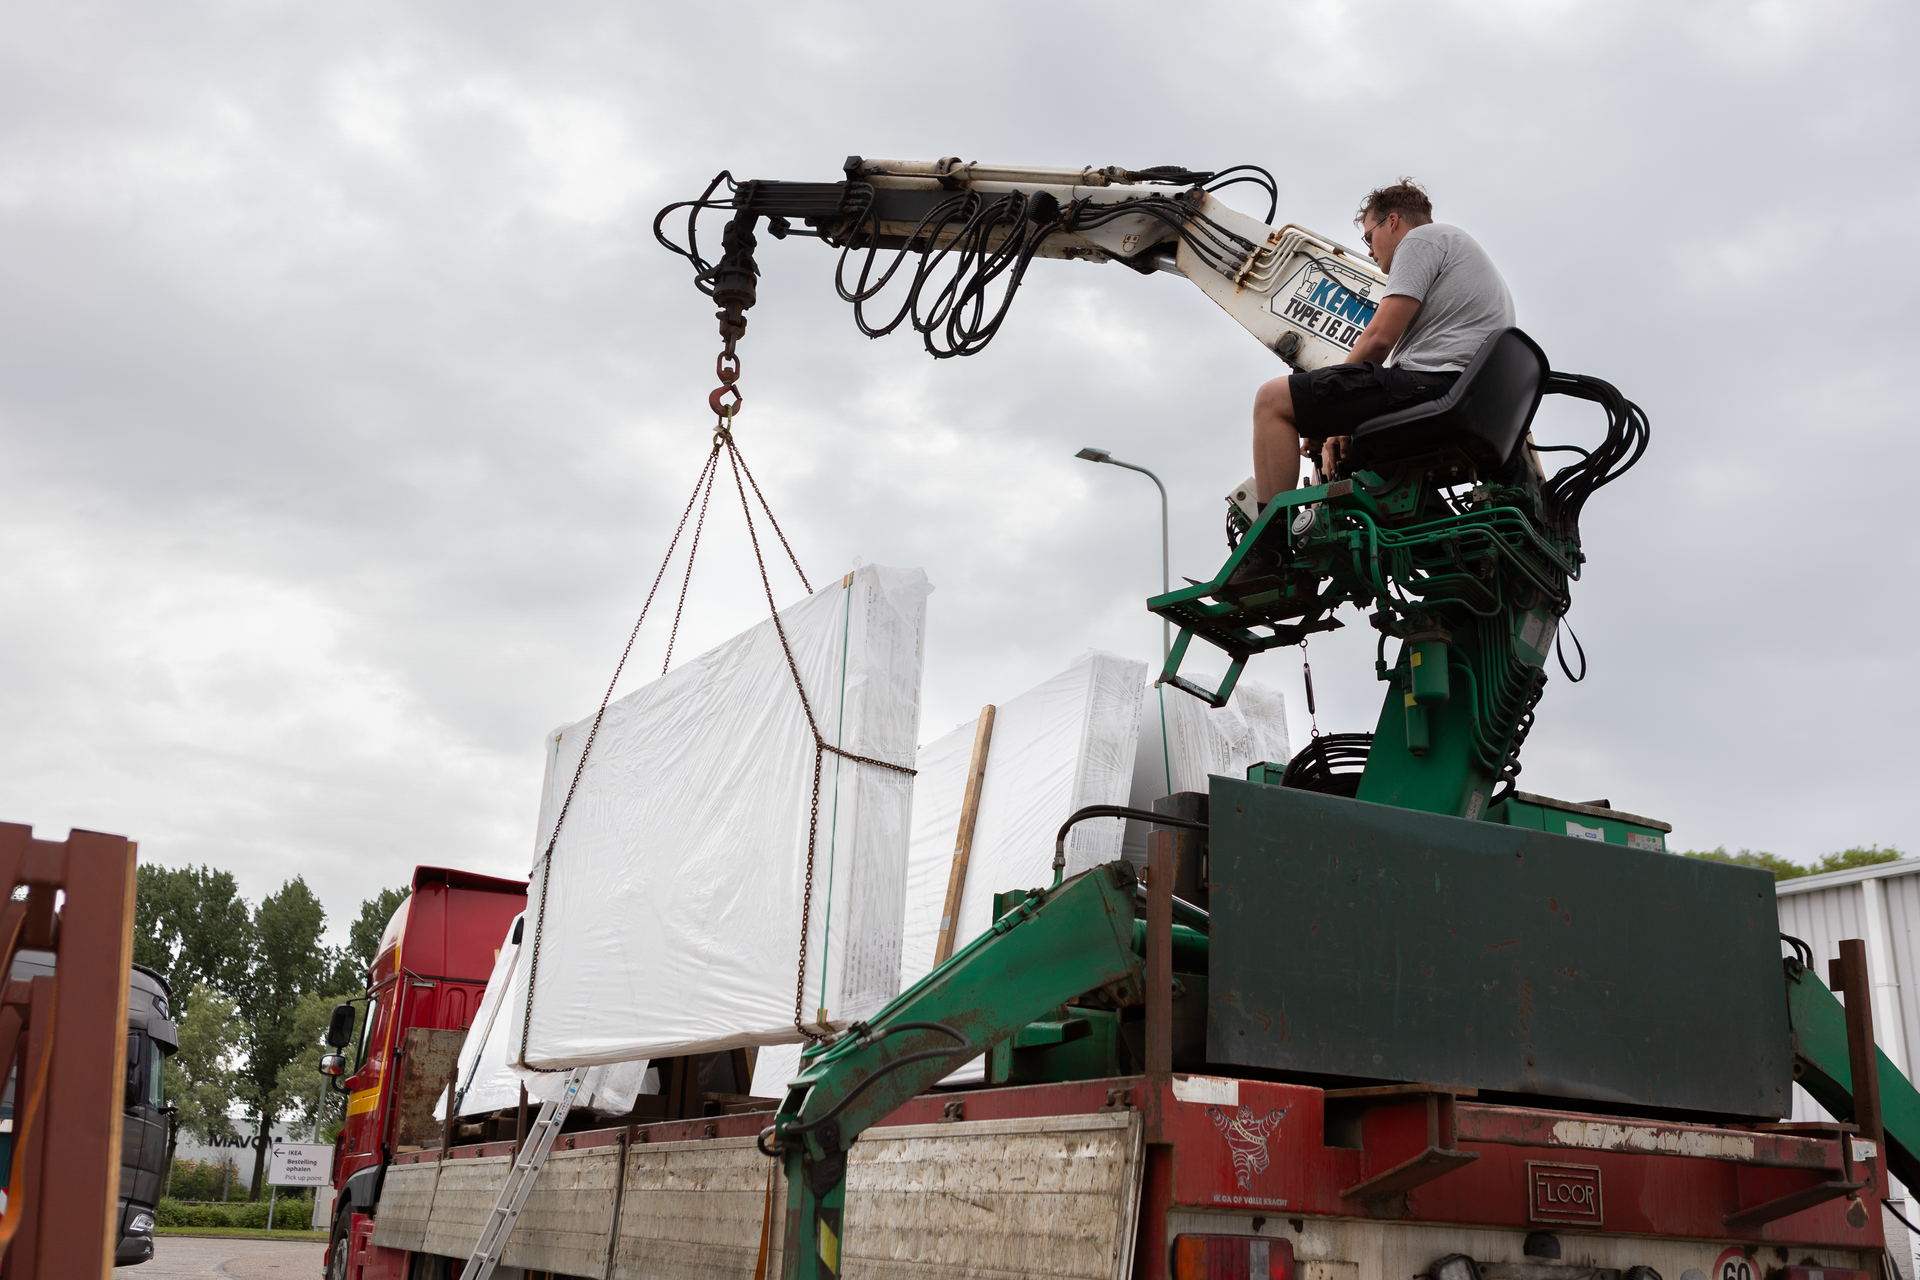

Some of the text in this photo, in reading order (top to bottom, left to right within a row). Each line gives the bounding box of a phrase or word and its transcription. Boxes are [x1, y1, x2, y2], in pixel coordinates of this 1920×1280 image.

[1284, 297, 1323, 328] TYPE
[1236, 1123, 1264, 1144] MICHELIN
[287, 1158, 318, 1167] Bestelling
[1213, 1194, 1222, 1203] IK
[1233, 1195, 1243, 1204] OP
[1243, 1196, 1262, 1205] VOLLE
[1263, 1197, 1288, 1207] KRACHT
[1536, 1179, 1595, 1211] FLOOR
